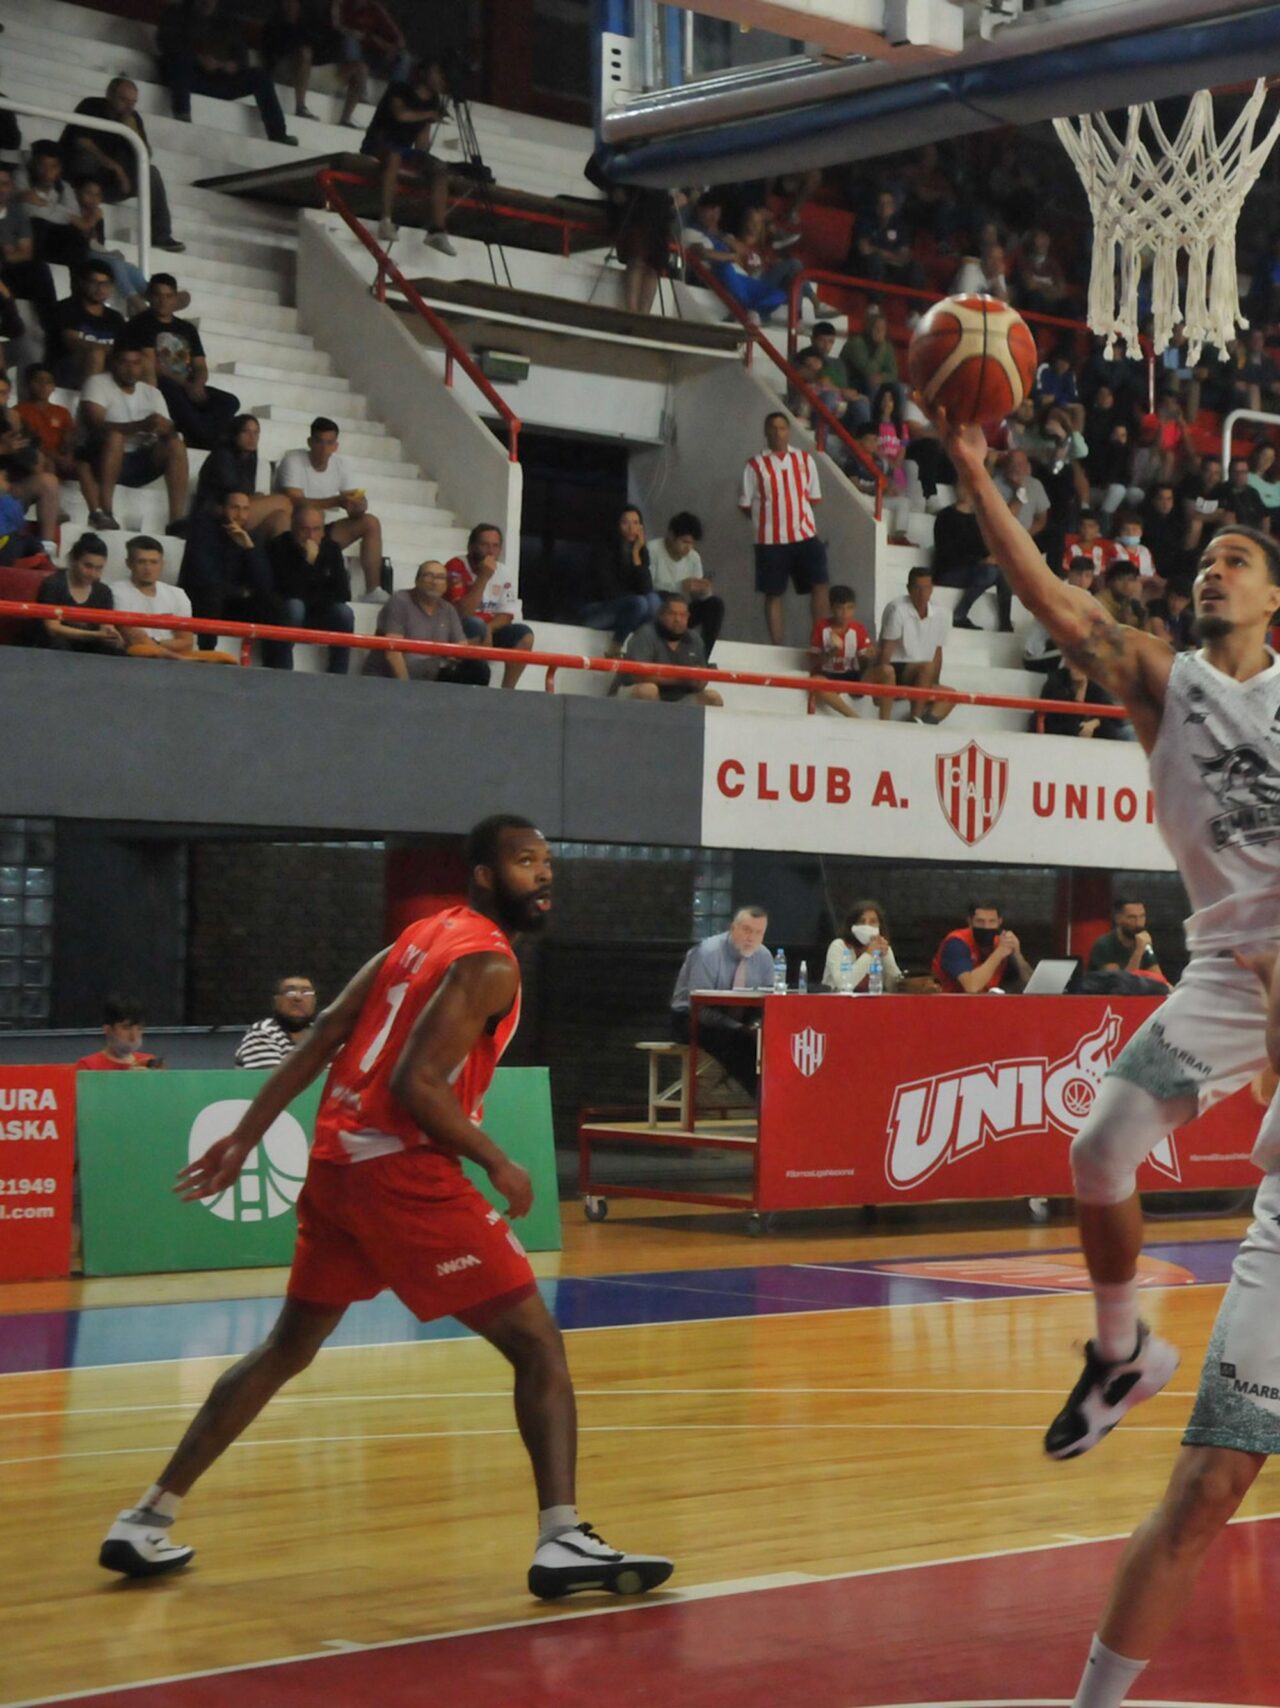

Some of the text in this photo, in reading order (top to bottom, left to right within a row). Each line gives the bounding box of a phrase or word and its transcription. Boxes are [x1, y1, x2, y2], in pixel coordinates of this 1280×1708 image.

[717, 759, 851, 804] CLUB
[871, 771, 909, 809] A.
[359, 982, 409, 1073] 1
